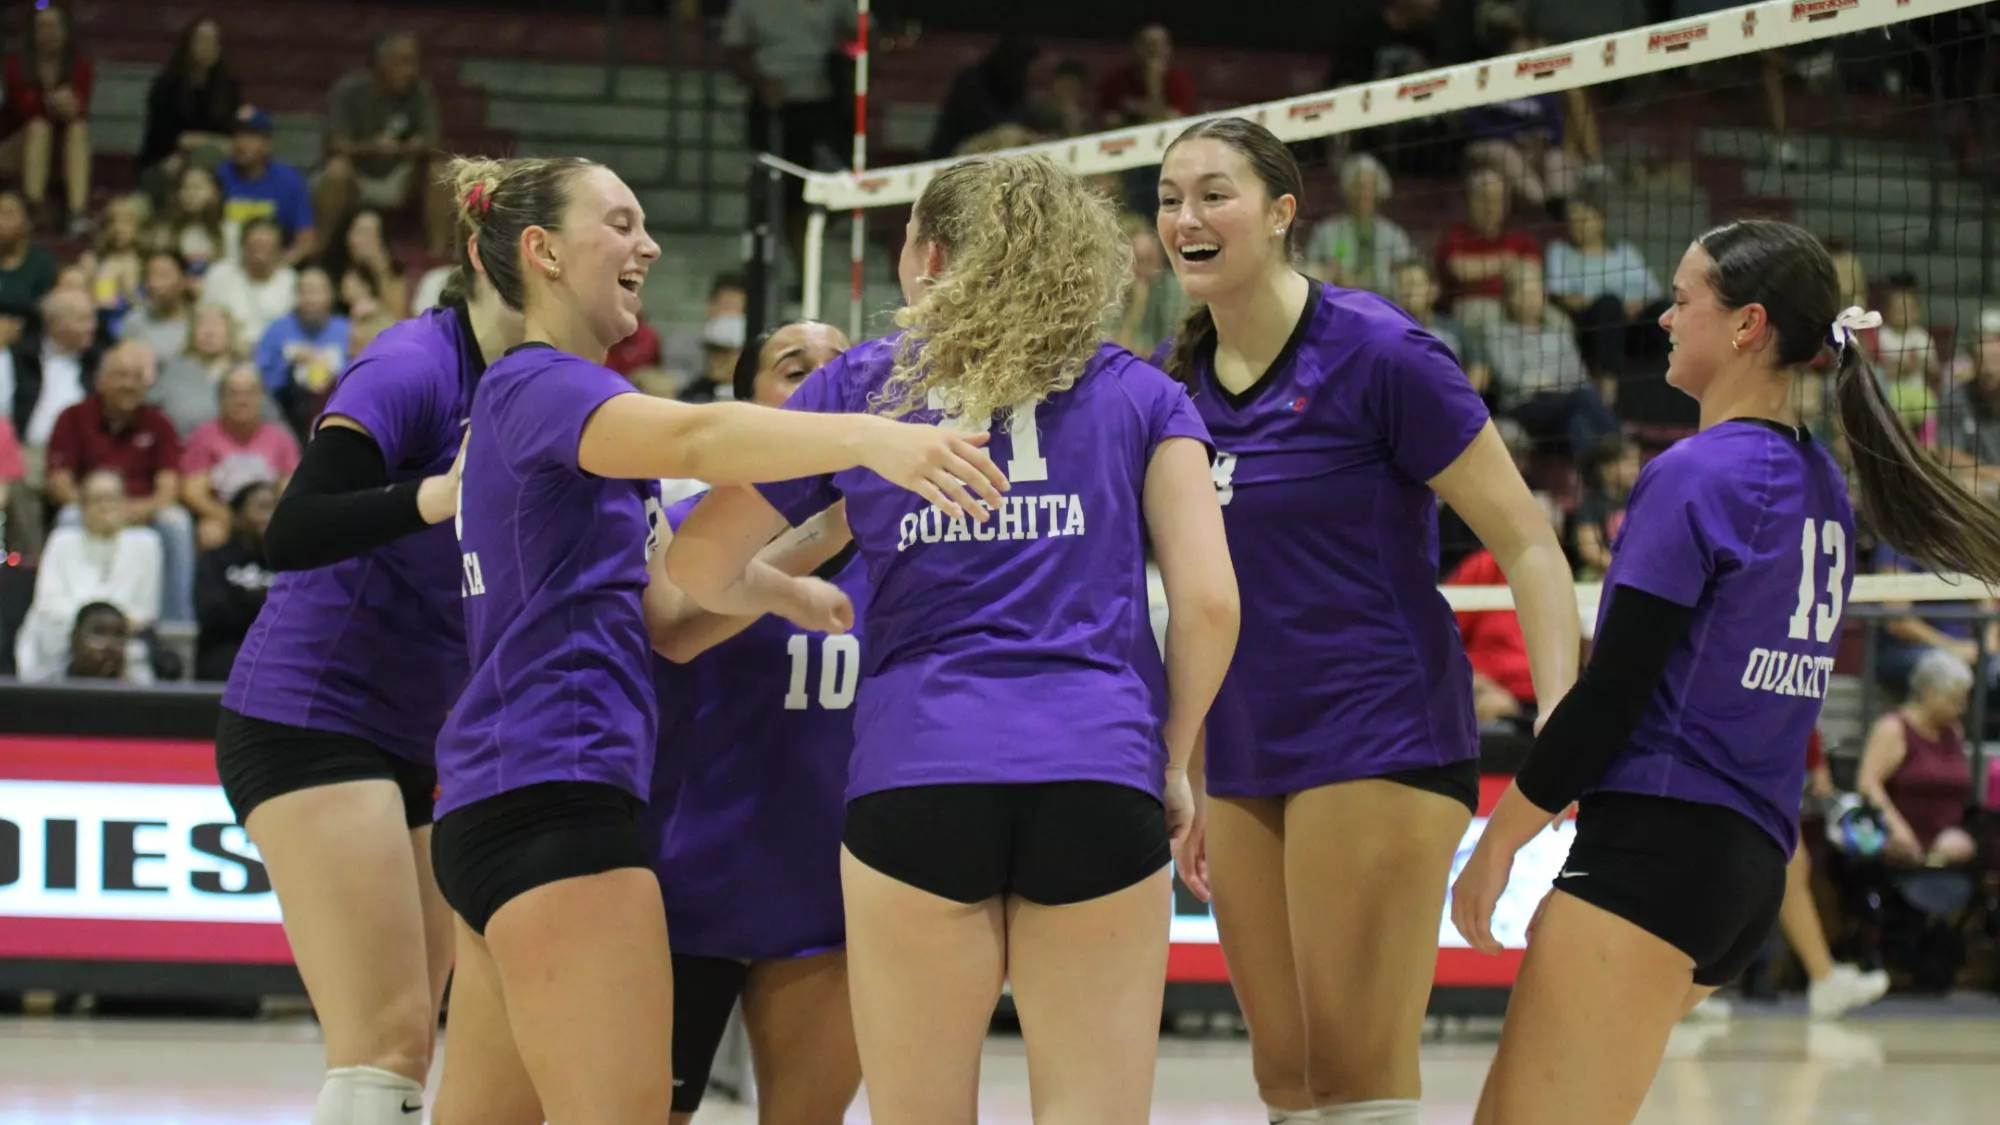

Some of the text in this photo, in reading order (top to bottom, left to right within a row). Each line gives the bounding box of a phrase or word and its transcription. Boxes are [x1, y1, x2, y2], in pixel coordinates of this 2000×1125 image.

[898, 494, 1085, 552] OUACHITA
[1787, 517, 1846, 643] 13
[784, 633, 860, 710] 10
